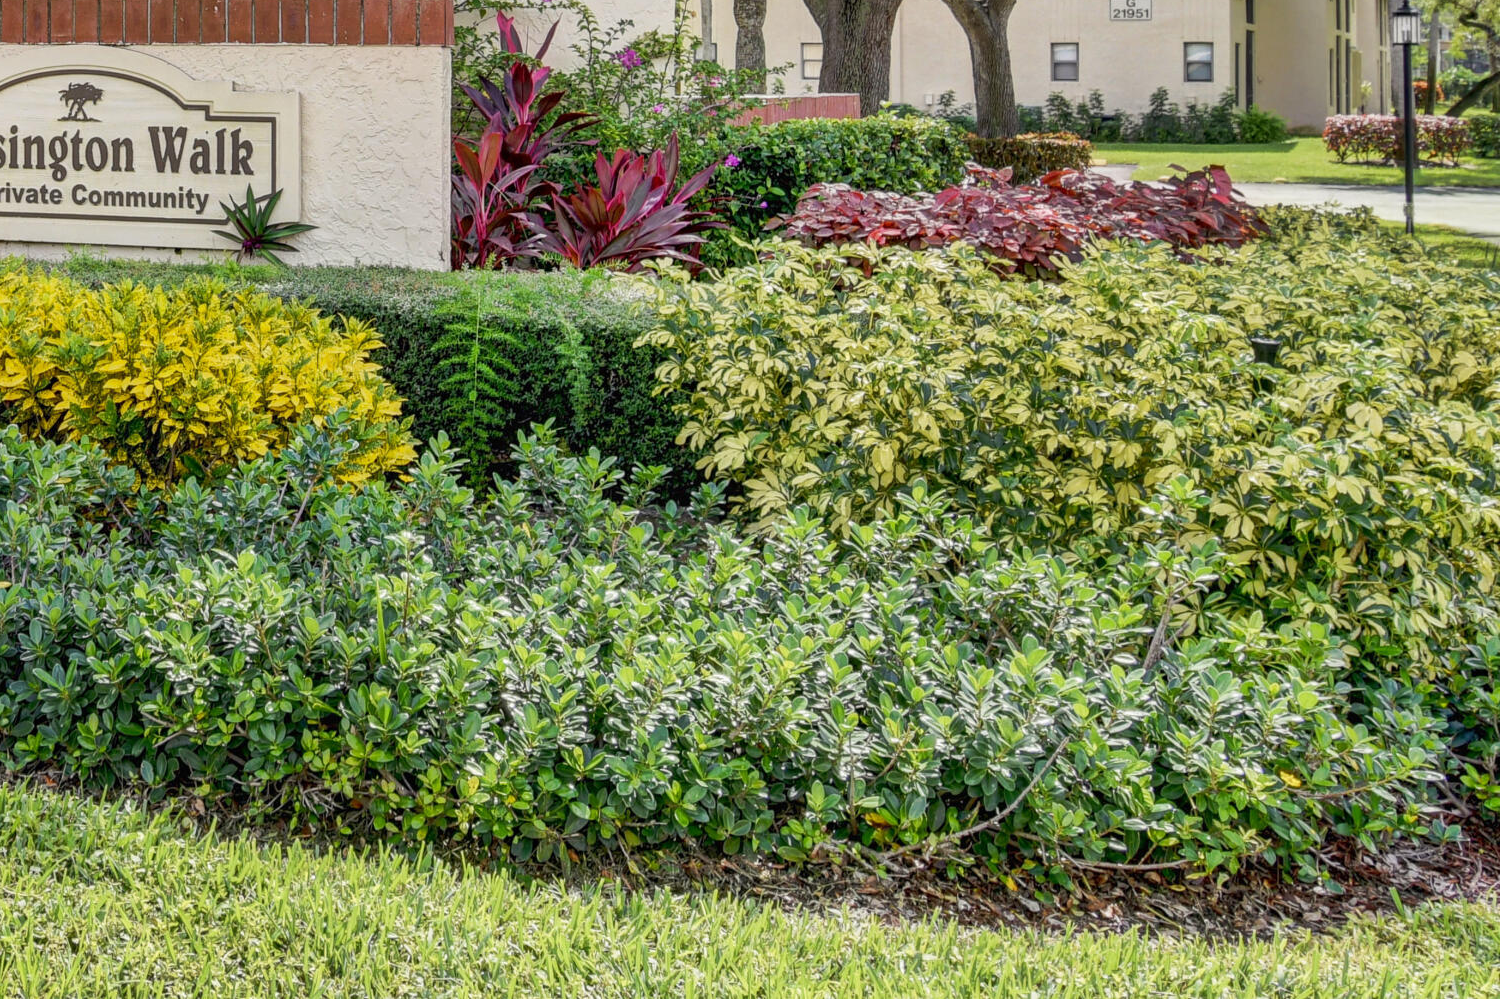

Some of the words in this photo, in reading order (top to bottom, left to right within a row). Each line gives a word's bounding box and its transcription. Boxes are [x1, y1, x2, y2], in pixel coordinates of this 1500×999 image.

[1113, 8, 1149, 19] 21951
[148, 125, 255, 176] Walk
[71, 184, 210, 215] Community
